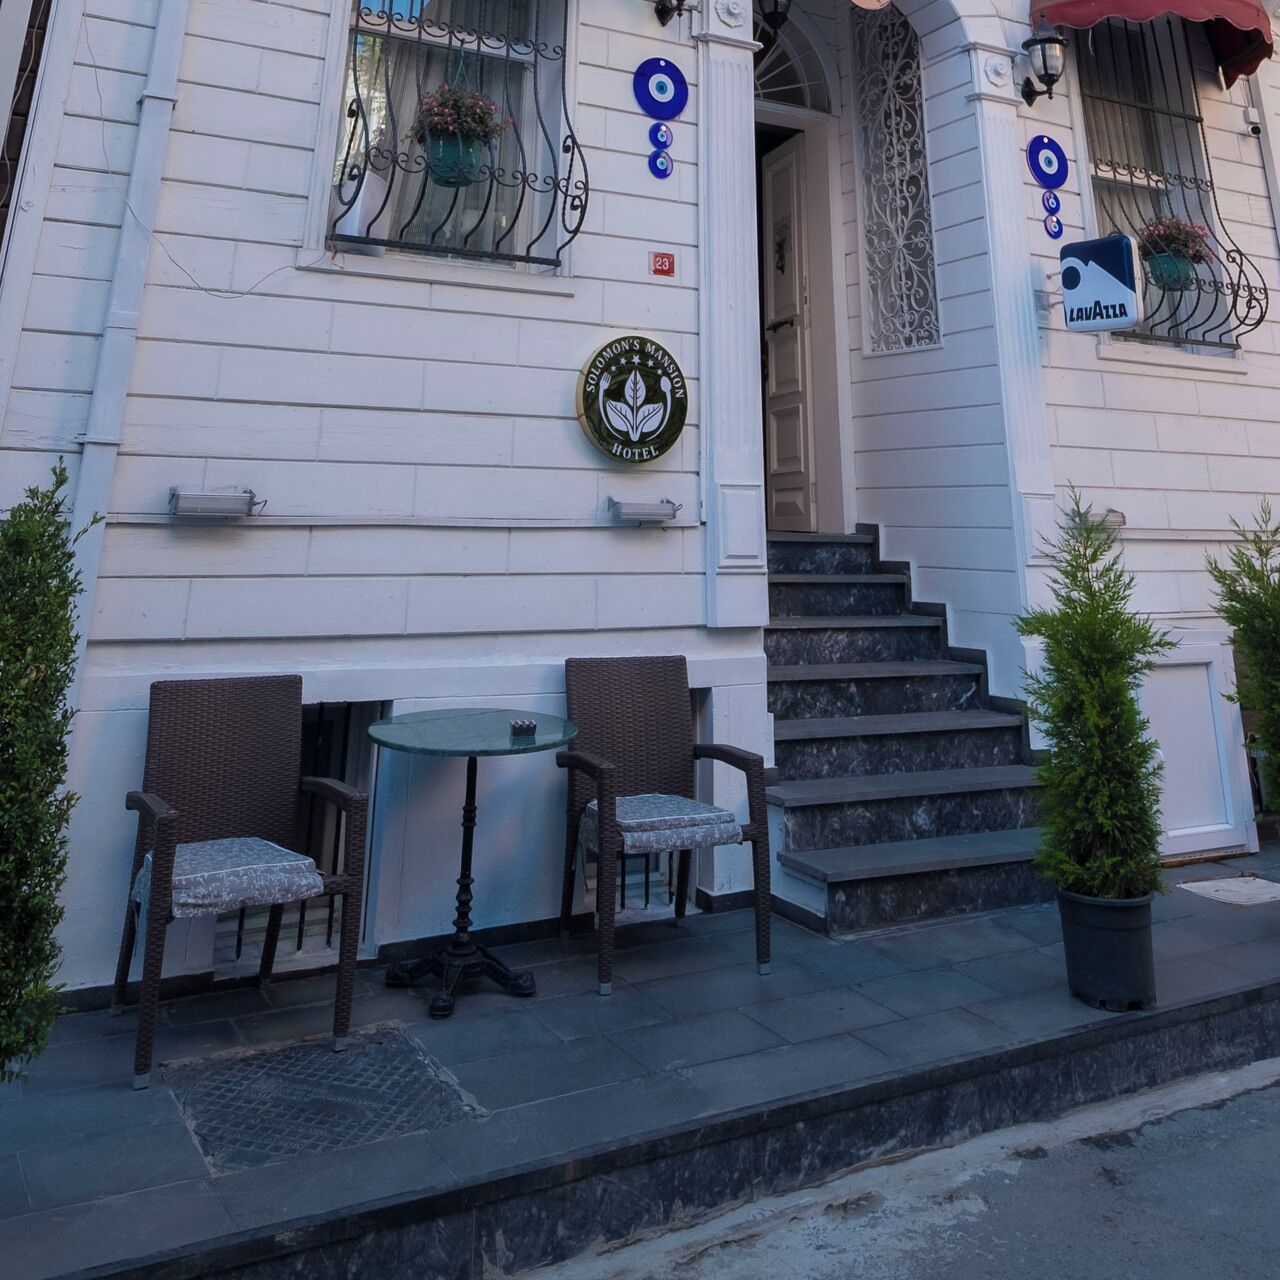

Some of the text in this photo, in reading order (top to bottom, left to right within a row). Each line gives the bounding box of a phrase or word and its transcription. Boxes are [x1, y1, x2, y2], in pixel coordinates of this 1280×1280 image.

[656, 257, 669, 270] 23
[1069, 300, 1128, 322] LAVAZZA
[586, 339, 685, 398] SOLOMON'S MANSION
[612, 443, 659, 460] HOTEL
